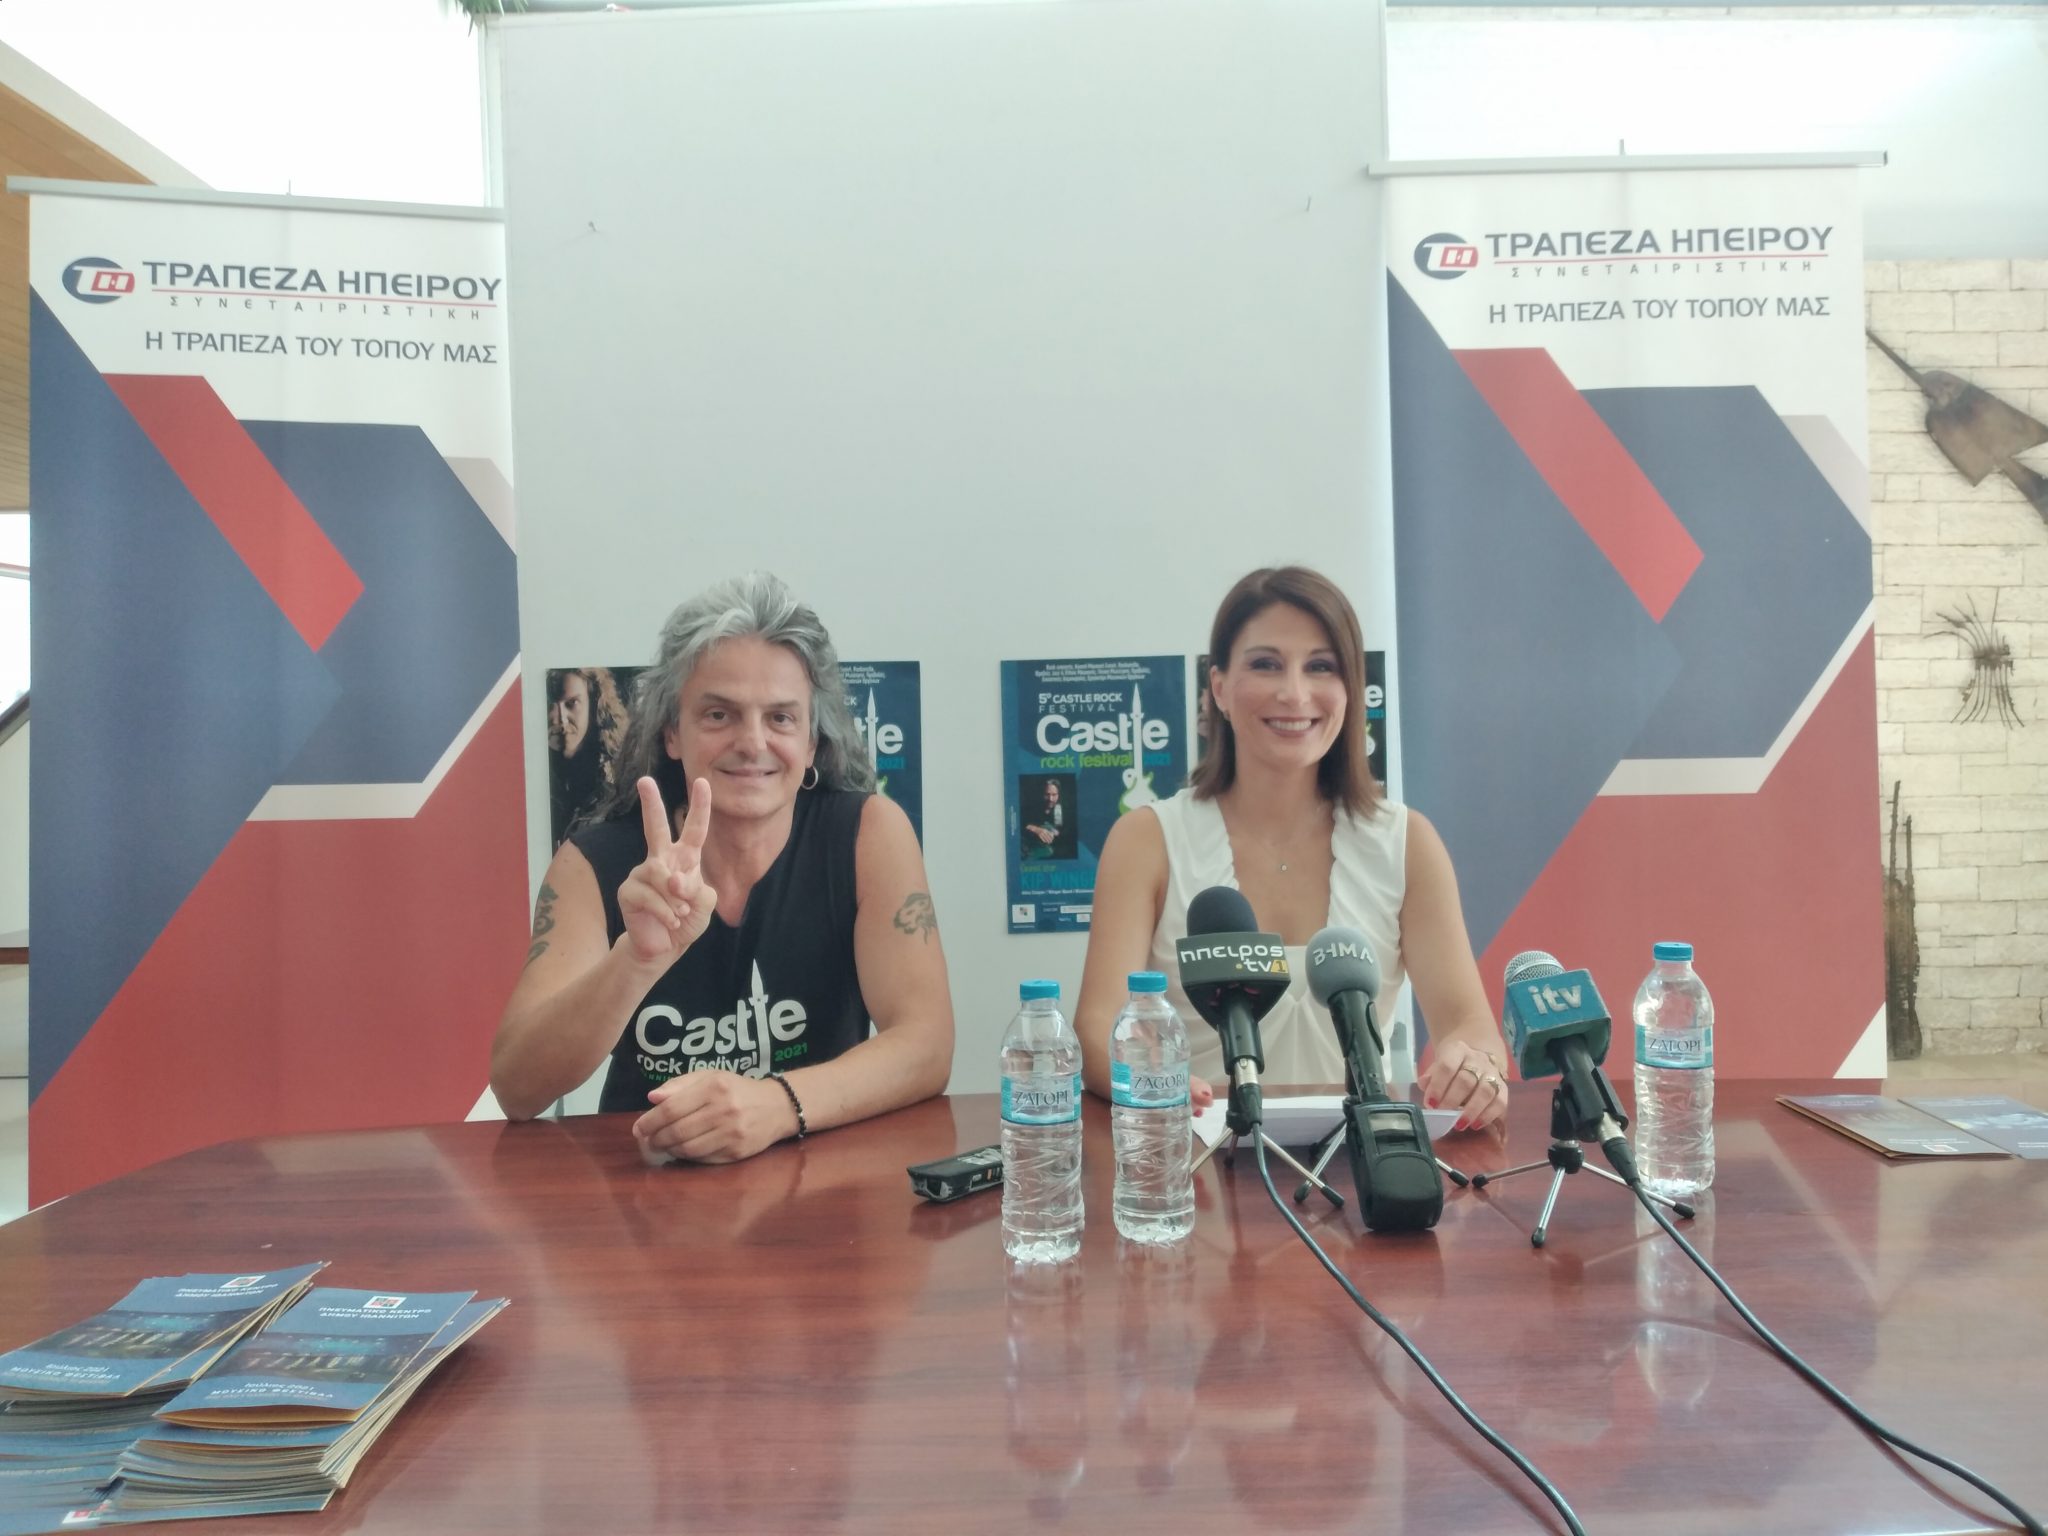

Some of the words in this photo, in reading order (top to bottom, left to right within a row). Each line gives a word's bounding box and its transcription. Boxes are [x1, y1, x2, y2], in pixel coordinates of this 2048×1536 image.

[1485, 229, 1661, 258] ΤΡΑΠΕΖΑ
[1672, 226, 1833, 253] ΗΠΕΙΡΟΥ
[142, 261, 326, 293] ΤΡΑΠΕΖΑ
[338, 270, 502, 302] ΗΠΕΙΡΟΥ
[1512, 261, 1812, 279] ΣΥΝΕΤΑΙΡΙΣΤΙΚΗ
[170, 295, 480, 321] ΣΥΝΕΤΑΙΡΙΣΤΙΚΗ
[1489, 304, 1506, 324] Η
[1515, 301, 1625, 322] ΤΡΑΠΕΖΑ
[1633, 299, 1678, 320] ΤΟΥ
[1686, 297, 1768, 319] ΤΟΠΟΥ
[1777, 296, 1831, 317] ΜΑΣ
[145, 331, 163, 350] Η
[172, 332, 287, 355] ΤΡΑΠΕΖΑ
[296, 336, 343, 357] ΤΟΥ
[351, 338, 434, 361] ΤΟΠΟΥ
[444, 343, 498, 364] ΜΑΣ
[1039, 703, 1115, 713] FESTIVAL
[1053, 694, 1092, 704] CASTLE
[1093, 692, 1122, 703] ROCK
[1036, 711, 1169, 753] Castle
[1040, 754, 1074, 769] rock
[1079, 752, 1132, 769] festival
[1527, 984, 1582, 1016] itv
[635, 995, 807, 1056] Castle
[636, 1054, 683, 1075] rock
[774, 1042, 808, 1062] 2021
